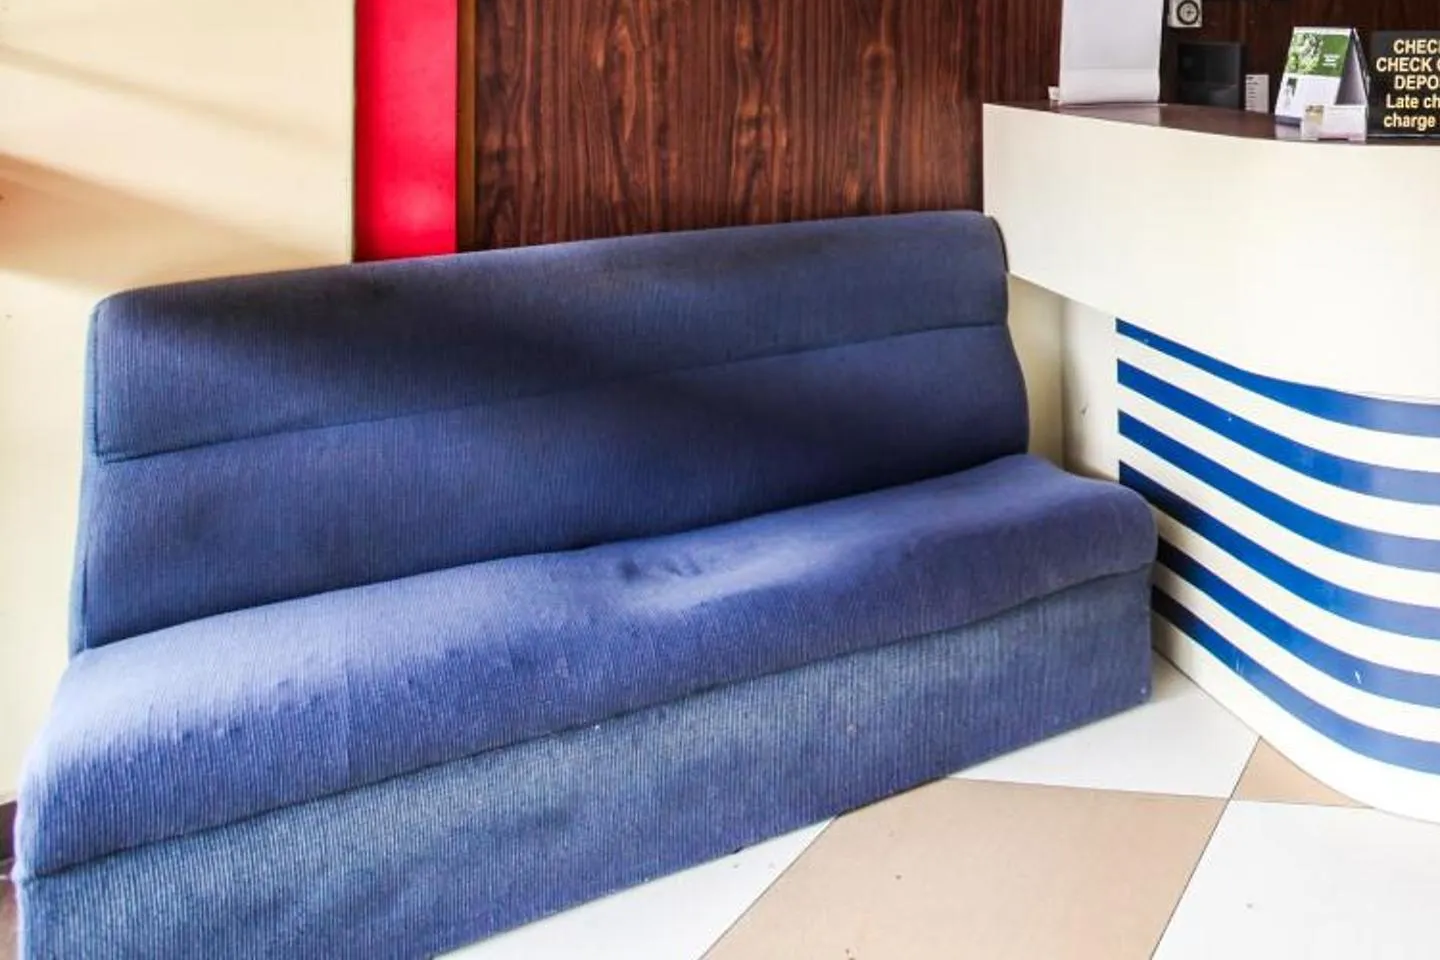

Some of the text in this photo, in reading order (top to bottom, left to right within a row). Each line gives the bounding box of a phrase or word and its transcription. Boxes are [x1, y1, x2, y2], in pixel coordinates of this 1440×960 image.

[1376, 57, 1434, 72] CHECK
[1386, 93, 1418, 108] Late
[1383, 113, 1436, 131] charge
